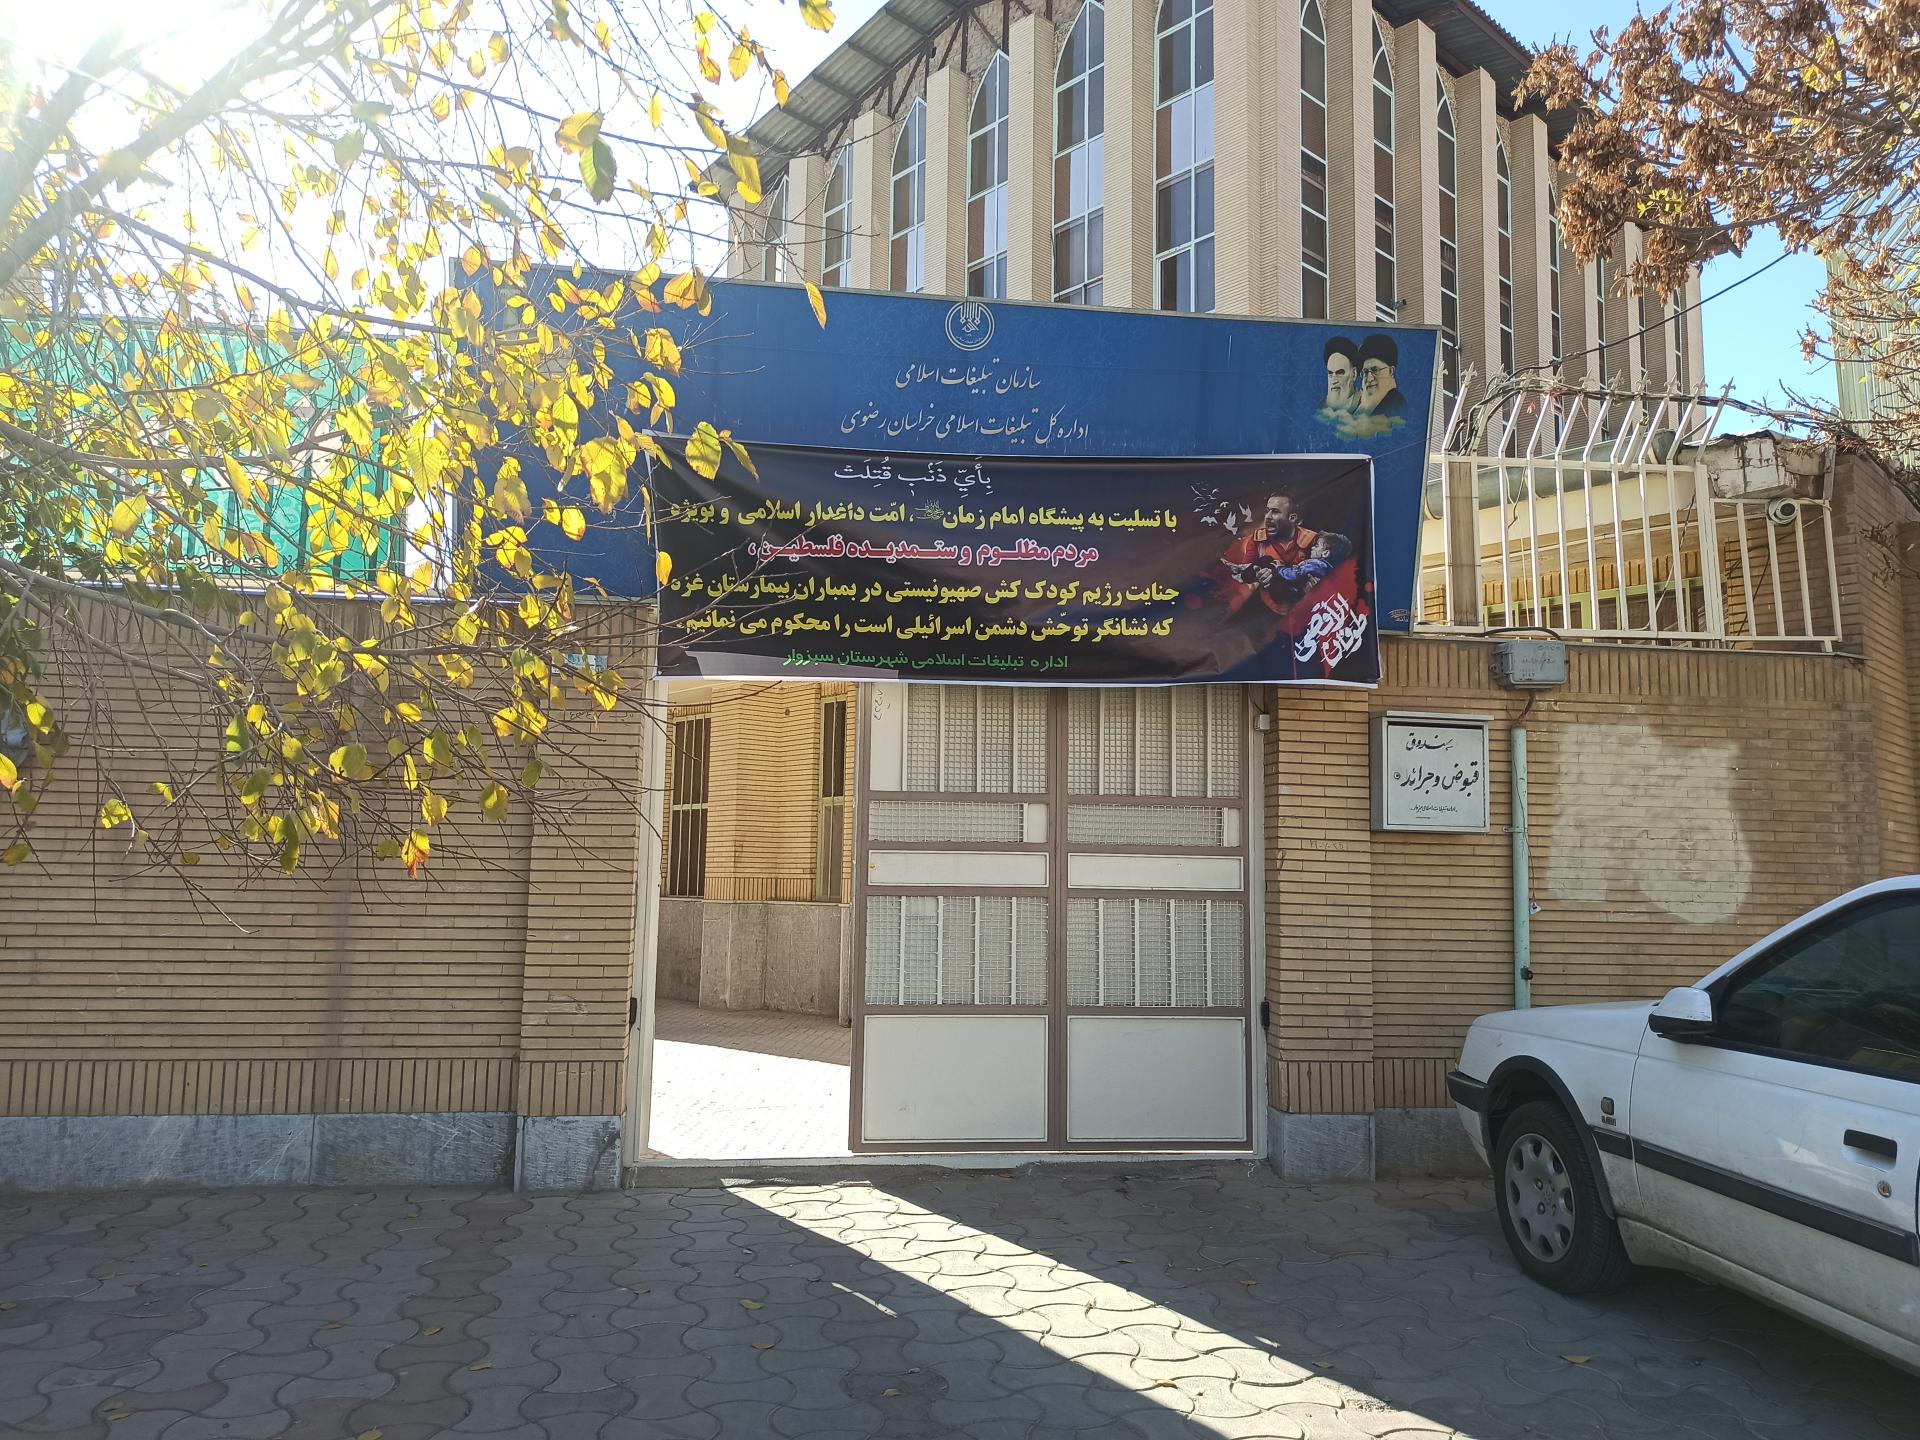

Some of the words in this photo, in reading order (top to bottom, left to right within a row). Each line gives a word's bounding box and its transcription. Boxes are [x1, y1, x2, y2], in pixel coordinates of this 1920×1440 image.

[895, 363, 939, 389] اسلامی
[940, 357, 1000, 395] تبلیغات
[995, 365, 1042, 394] سازمان
[840, 400, 887, 434] رضوی
[887, 402, 935, 437] خراسان
[935, 413, 979, 440] اسلامی
[980, 407, 1039, 444] تبلیغات
[1035, 403, 1066, 444] کل
[1057, 421, 1089, 439] اداره
[670, 498, 715, 523] بویژه
[719, 503, 730, 525] و
[737, 499, 801, 525] اسلامی
[805, 502, 865, 527] داغدار
[989, 505, 1025, 530] امام
[1028, 507, 1084, 533] پیشگاه
[1087, 511, 1105, 531] به
[1108, 508, 1161, 532] تسلیت
[1164, 509, 1178, 533] با
[846, 537, 957, 564] ستمدیده
[958, 543, 971, 566] و
[976, 538, 1050, 566] مظلوم
[1051, 544, 1099, 567] مردم
[670, 573, 704, 597] غزه
[707, 573, 790, 599] بیمارستان
[794, 576, 857, 602] بمباران
[860, 579, 882, 603] در
[885, 578, 981, 604] صهیونیستی
[984, 579, 1021, 604] کش
[1024, 580, 1079, 606] کودک
[1082, 582, 1122, 607] رژیم
[1125, 582, 1180, 606] جنایت
[739, 616, 768, 635] می
[771, 612, 831, 636] محکوم
[834, 613, 851, 638] را
[854, 615, 892, 635] است
[896, 613, 971, 642] اسرائیلی
[974, 616, 1026, 641] دشمن
[1092, 616, 1148, 643] نشانگر
[1150, 616, 1173, 639] که
[783, 648, 834, 666] سبزوار
[838, 649, 909, 667] شهرستان
[911, 652, 965, 669] اسلامی
[967, 655, 1024, 669] تبلیغات
[1030, 655, 1068, 672] اداره
[1400, 765, 1435, 795] جرائد
[1432, 774, 1441, 788] و
[1441, 761, 1480, 797] قبوض
